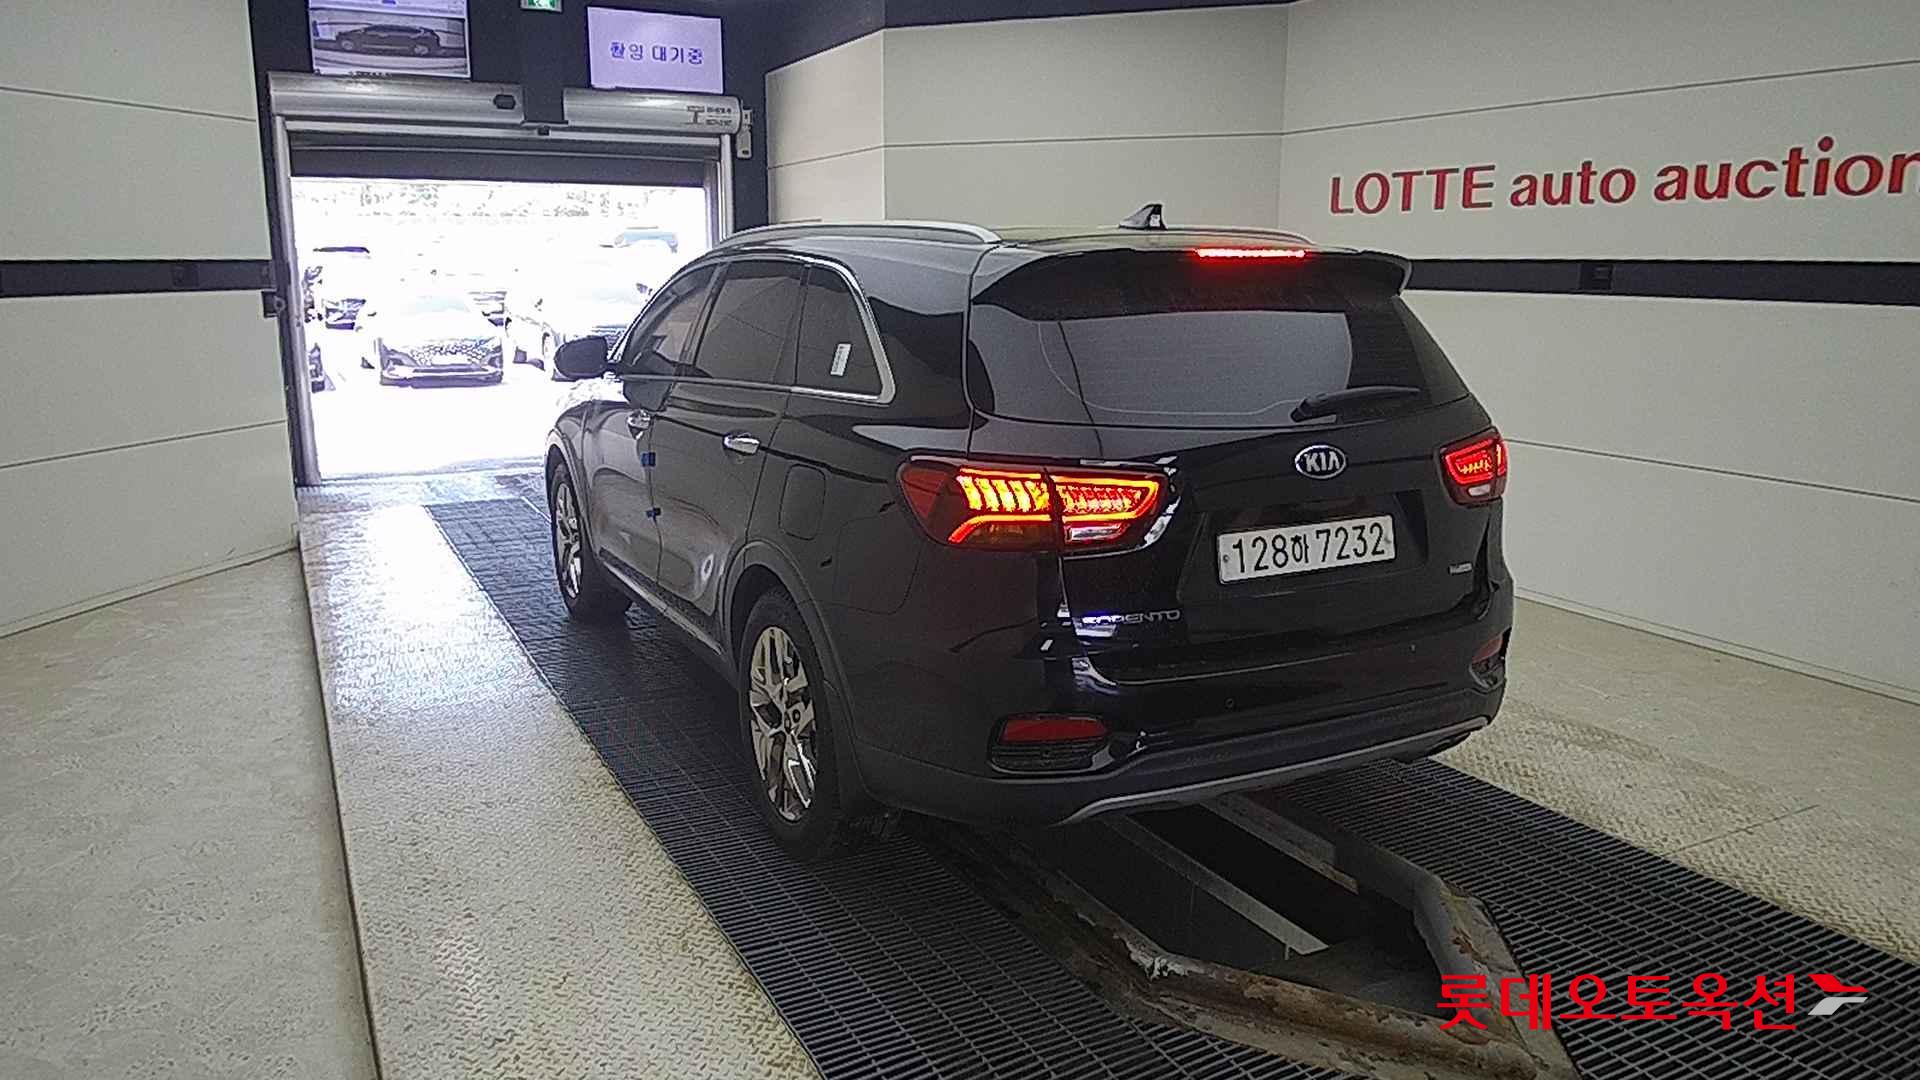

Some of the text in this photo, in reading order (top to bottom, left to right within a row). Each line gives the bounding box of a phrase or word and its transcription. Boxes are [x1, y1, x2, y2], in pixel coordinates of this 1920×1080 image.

[1330, 165, 1496, 214] LOTTE
[1510, 160, 1636, 206] auto
[1304, 451, 1340, 472] KIA
